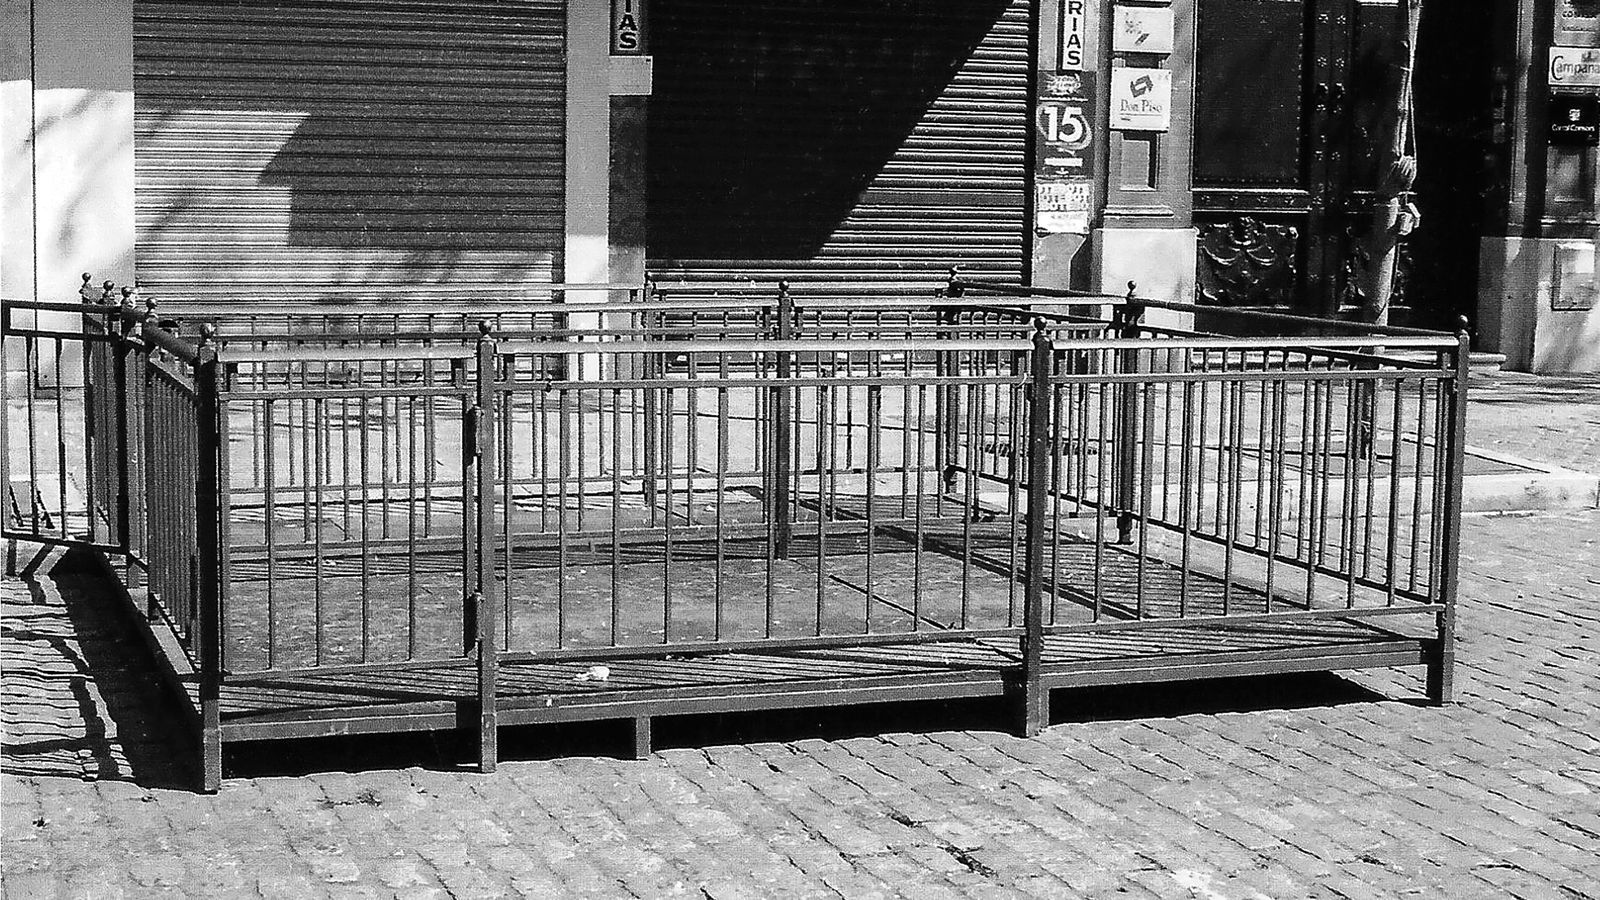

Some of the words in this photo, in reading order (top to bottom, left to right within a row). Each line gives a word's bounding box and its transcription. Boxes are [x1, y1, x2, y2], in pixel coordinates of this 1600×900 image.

[1067, 0, 1082, 66] RIAS
[1043, 105, 1083, 142] 15
[1120, 99, 1139, 112] Don
[1141, 99, 1163, 113] Piso
